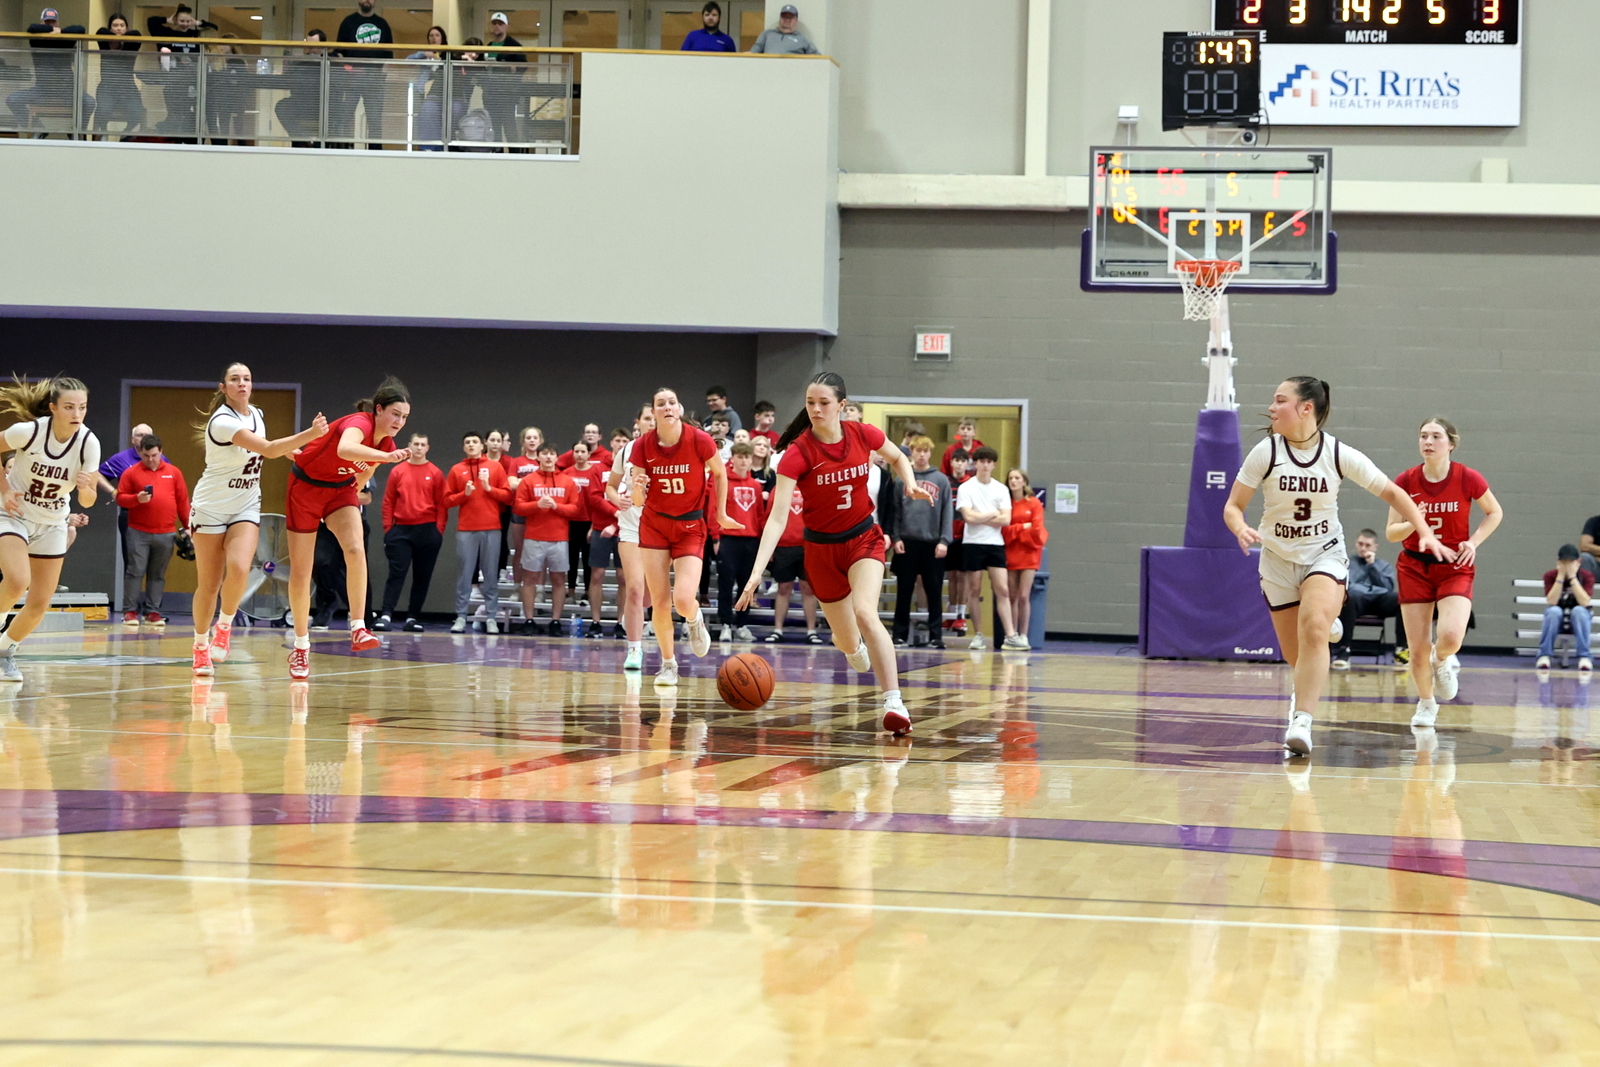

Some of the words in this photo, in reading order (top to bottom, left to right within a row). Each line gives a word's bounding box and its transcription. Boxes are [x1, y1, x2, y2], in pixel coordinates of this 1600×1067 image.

[1243, 0, 1262, 24] 2
[1289, 0, 1306, 24] 3
[1427, 0, 1445, 24] 5
[1482, 0, 1499, 24] 3
[1345, 30, 1387, 43] MATCH
[1465, 30, 1504, 43] SCORE
[1200, 39, 1252, 64] 1:47
[1330, 99, 1381, 109] HEALTH
[1387, 99, 1459, 109] PARTNERS
[923, 334, 946, 351] EXIT
[30, 462, 69, 481] GENOA
[816, 462, 869, 485] BELLEVUE
[30, 479, 61, 499] 22
[658, 478, 685, 494] 30
[1279, 475, 1329, 493] GENOA
[836, 484, 853, 510] 3
[1293, 498, 1312, 521] 3
[1274, 520, 1328, 539] COMETS
[1429, 517, 1443, 539] 2
